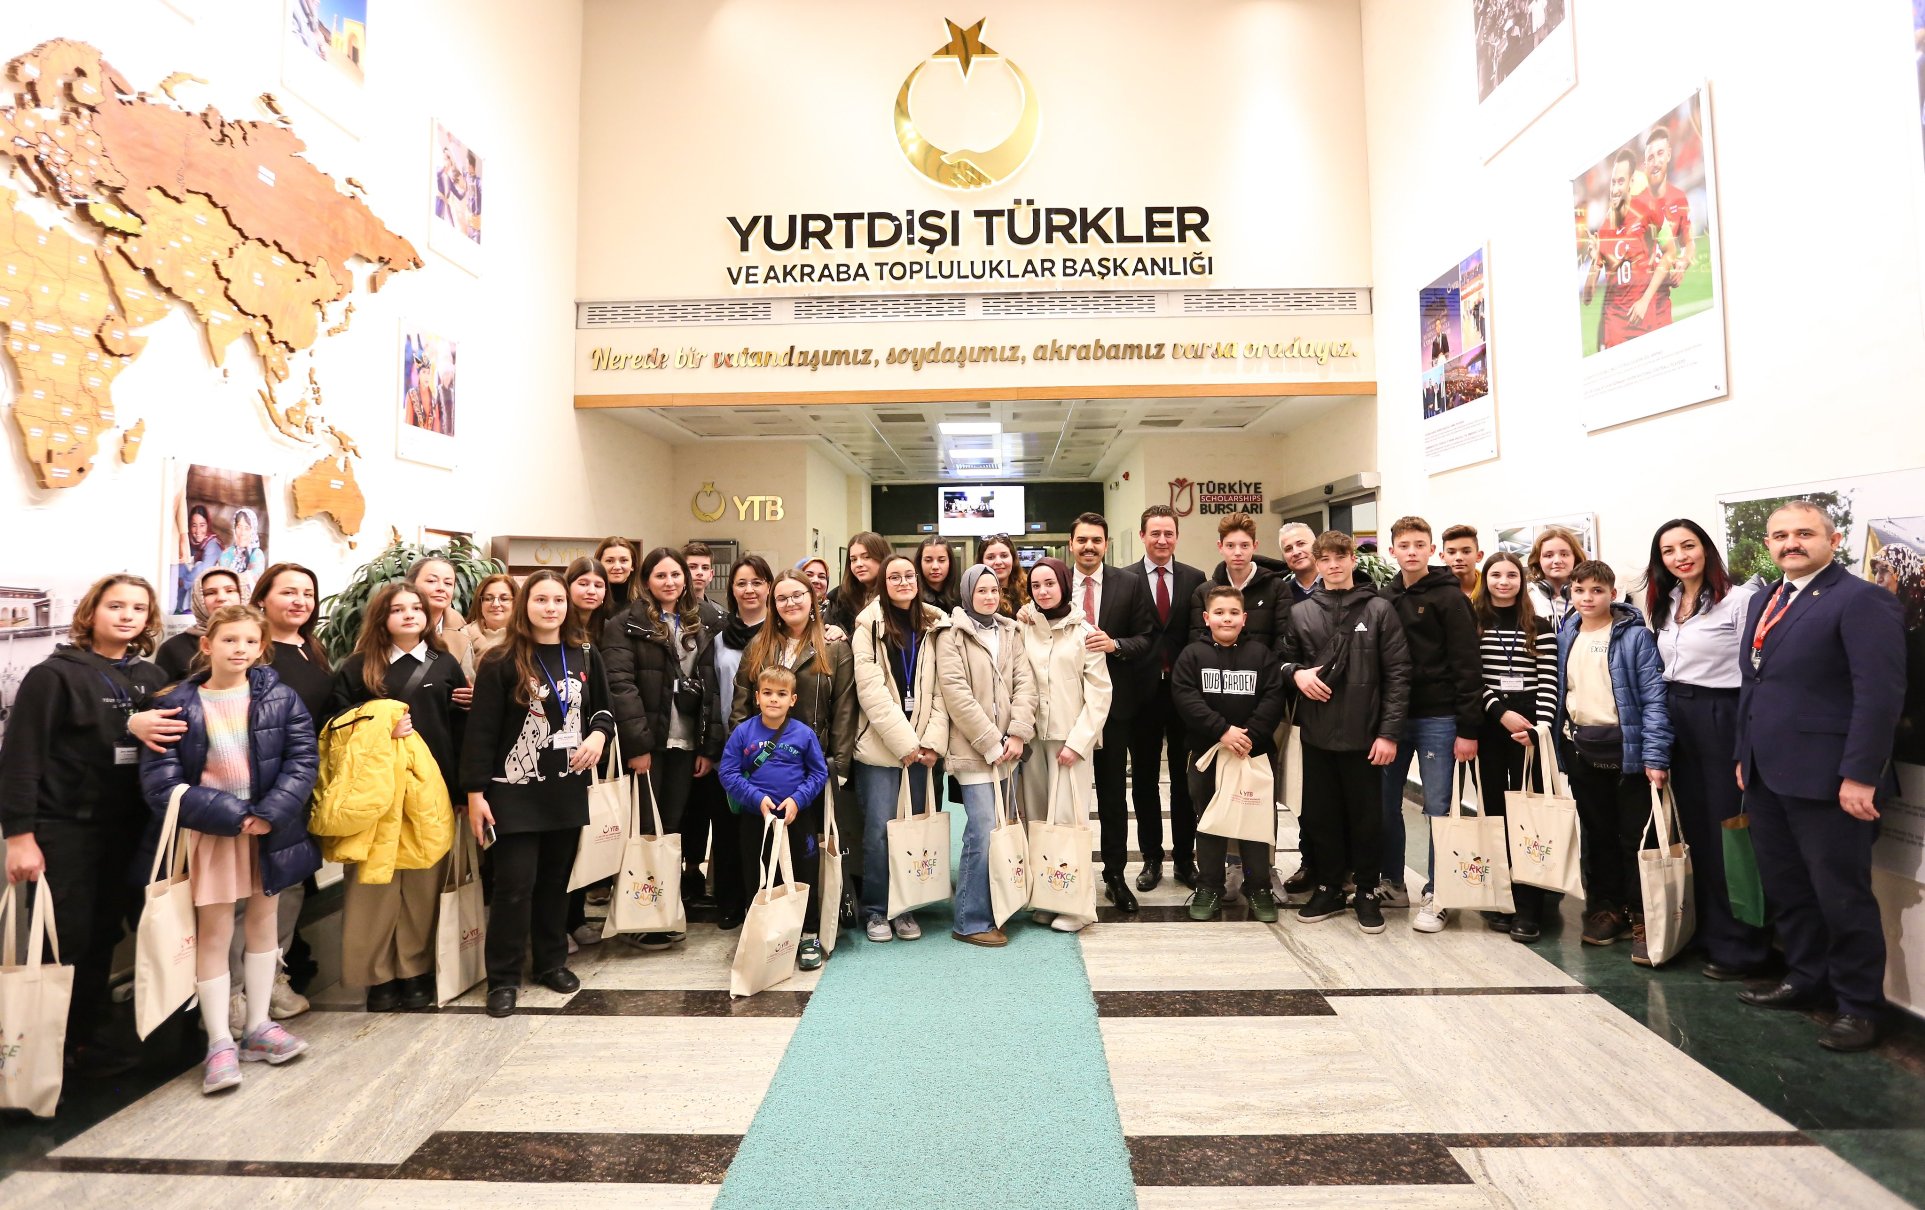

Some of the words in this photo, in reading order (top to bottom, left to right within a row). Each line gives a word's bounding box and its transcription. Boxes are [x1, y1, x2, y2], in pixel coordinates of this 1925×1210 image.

[973, 198, 1211, 246] TÜRKLER
[726, 265, 759, 286] VE
[763, 263, 870, 284] AKRABA
[874, 258, 1056, 281] TOPLULUKLAR
[1062, 251, 1213, 280] BAŞKANLIĞI
[591, 346, 669, 371] Nerede
[674, 346, 708, 370] bir
[713, 344, 880, 372] vatandaşımız,
[886, 341, 1028, 371] soydaşımız,
[1033, 338, 1166, 362] akrabamız
[1171, 341, 1239, 360] varsa
[1196, 479, 1263, 495] TÜRKİYE
[1201, 495, 1262, 503] SCHOLARSHIPS
[732, 495, 785, 521] YTB
[1203, 672, 1220, 690] DUB
[1223, 673, 1256, 692] GARDEN
